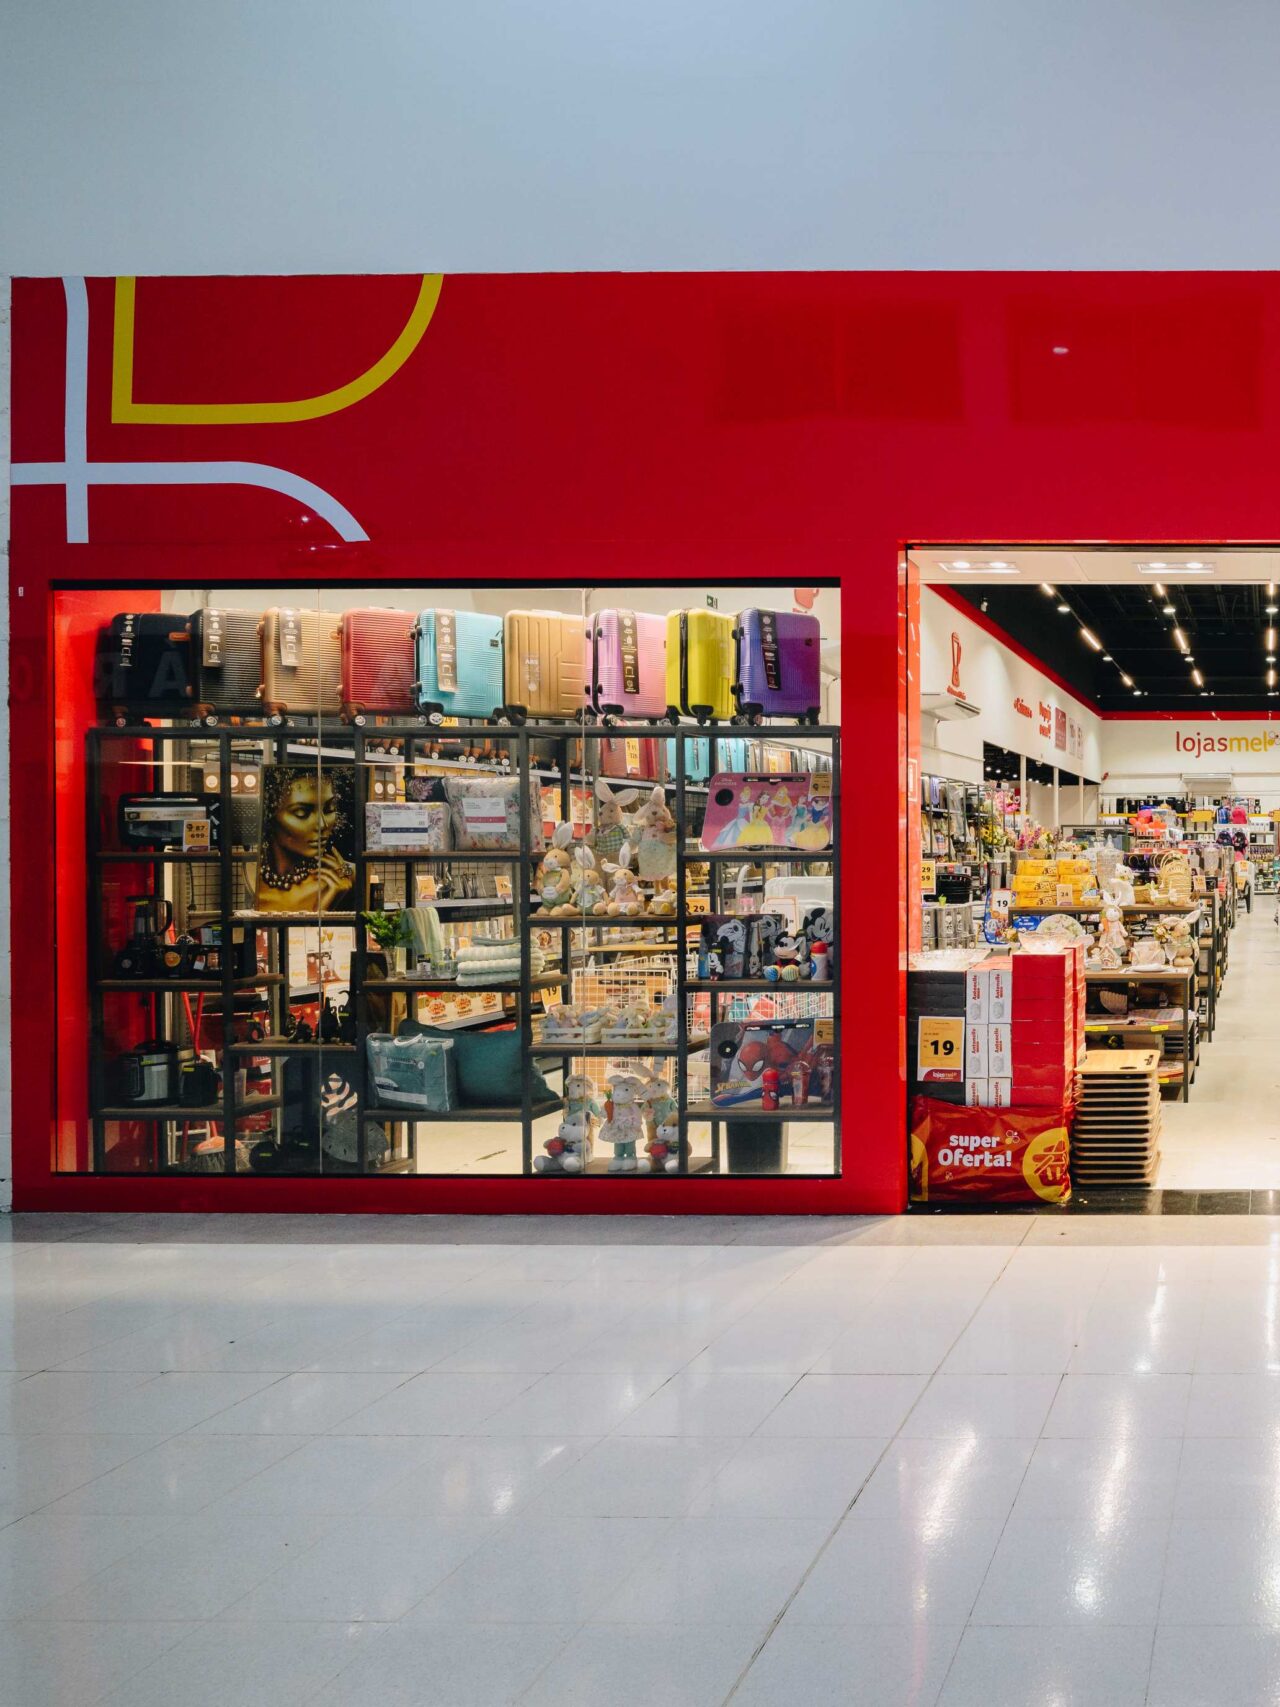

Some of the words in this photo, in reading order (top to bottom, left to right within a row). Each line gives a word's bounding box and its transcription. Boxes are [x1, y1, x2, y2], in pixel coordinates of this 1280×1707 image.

[1175, 730, 1268, 758] lojasmel
[546, 987, 557, 996] 19
[930, 1040, 954, 1055] 19
[949, 1134, 1000, 1150] super
[938, 1148, 1012, 1167] Oferta!
